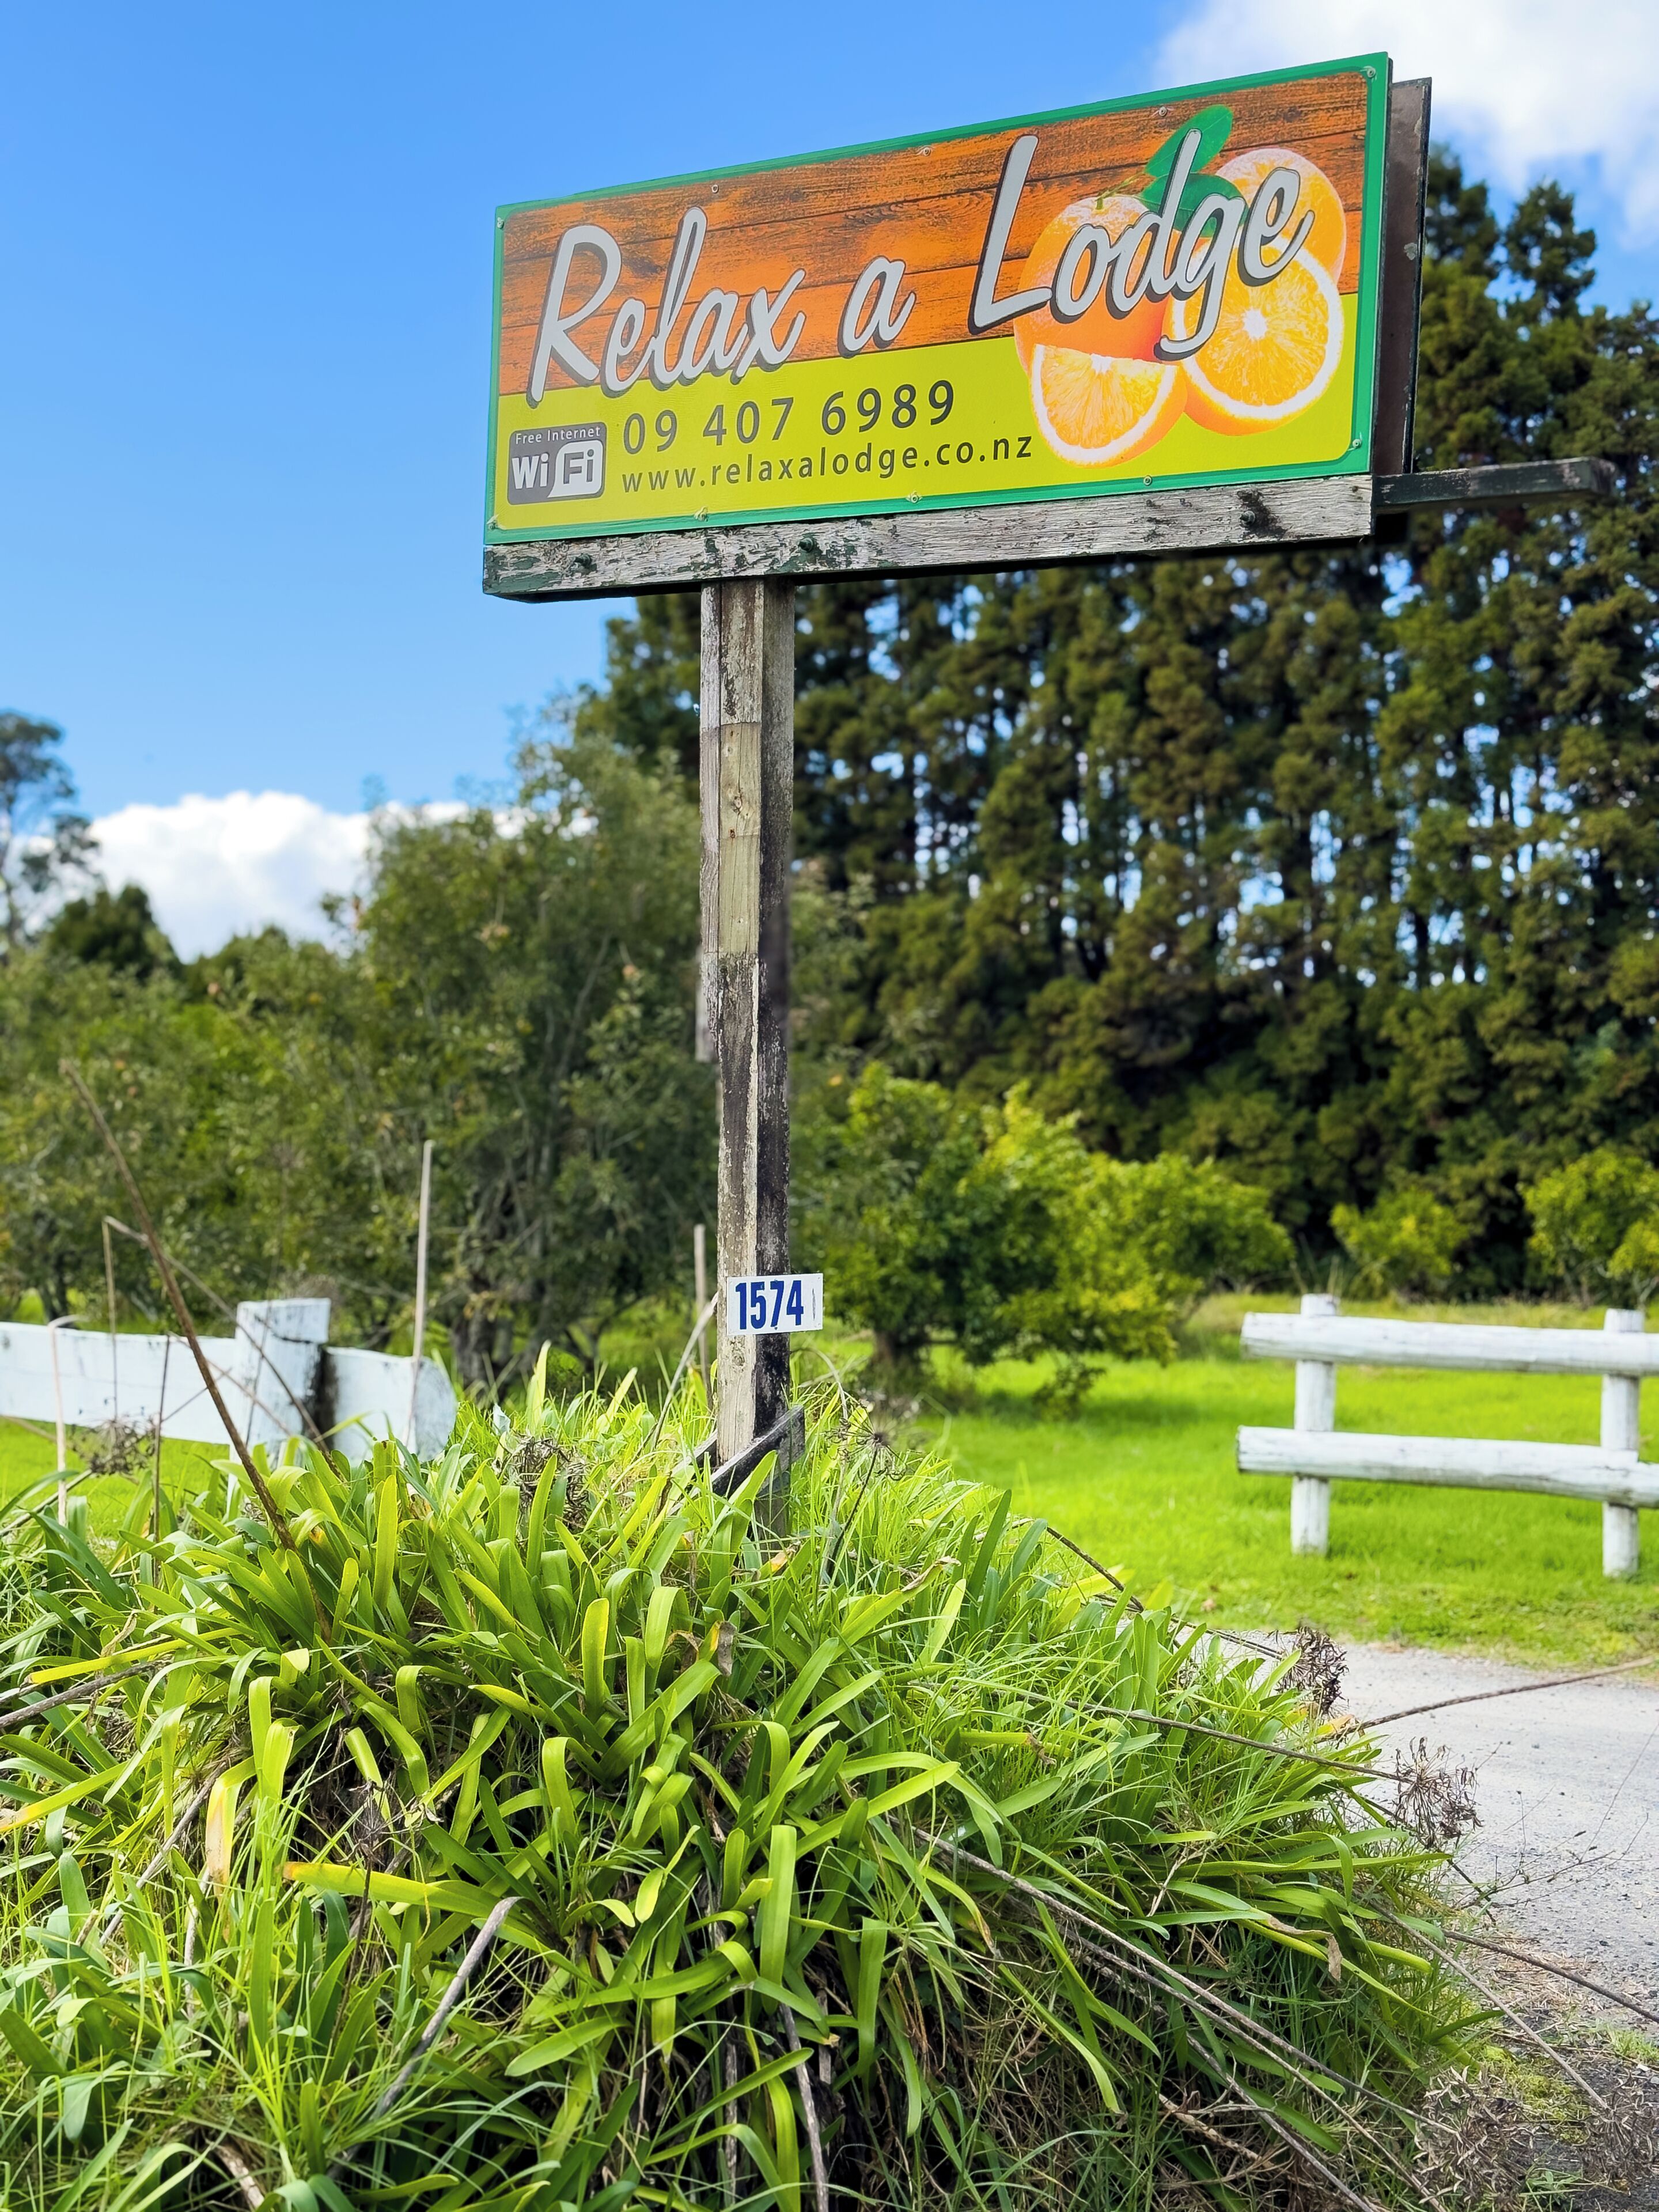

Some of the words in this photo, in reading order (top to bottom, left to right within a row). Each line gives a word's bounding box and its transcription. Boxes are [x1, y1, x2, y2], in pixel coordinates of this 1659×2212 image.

[527, 207, 806, 408] Relax
[838, 255, 916, 358] a
[968, 128, 1315, 361] Lodge
[516, 433, 542, 444] Free
[548, 426, 600, 441] Internet
[623, 410, 677, 454] 09
[702, 397, 795, 446] 407
[821, 379, 955, 436] 6989
[622, 435, 1032, 493] www.relaxalodge.co.nz
[735, 1280, 804, 1330] 1574
